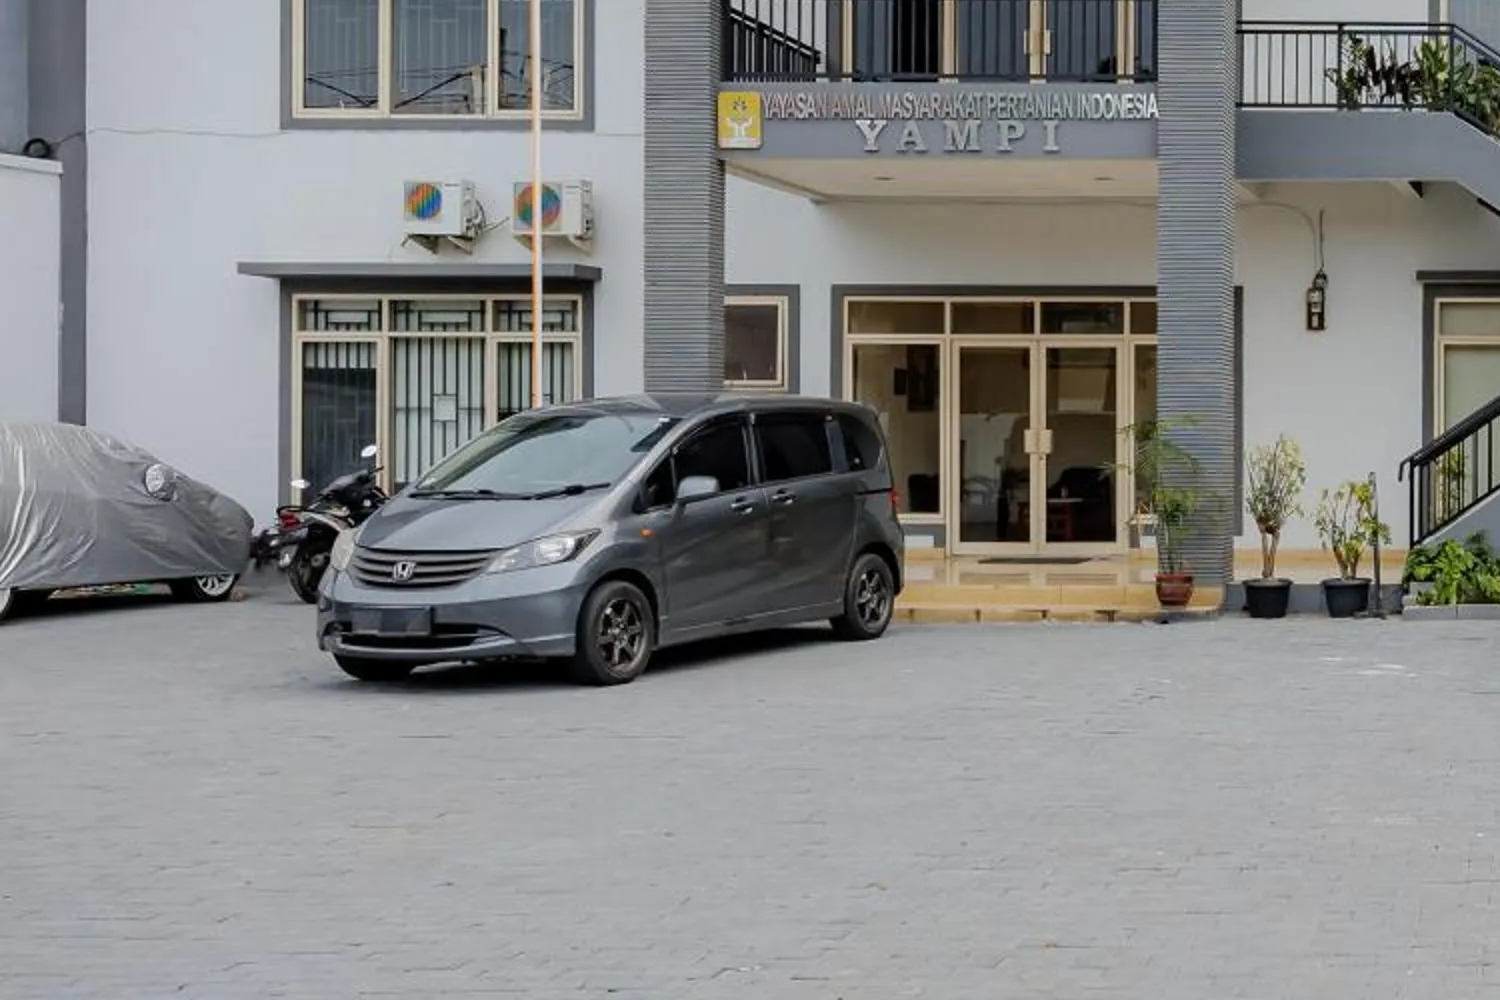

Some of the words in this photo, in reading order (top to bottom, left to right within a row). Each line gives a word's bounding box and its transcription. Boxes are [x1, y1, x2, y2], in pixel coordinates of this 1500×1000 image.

[761, 92, 827, 119] YAYASAN
[832, 92, 876, 119] AMAL
[879, 91, 982, 119] MASYARAKAT
[985, 92, 1073, 119] PERTANIAN
[1076, 92, 1159, 119] INDONESIA
[855, 119, 1060, 152] YAMPI
